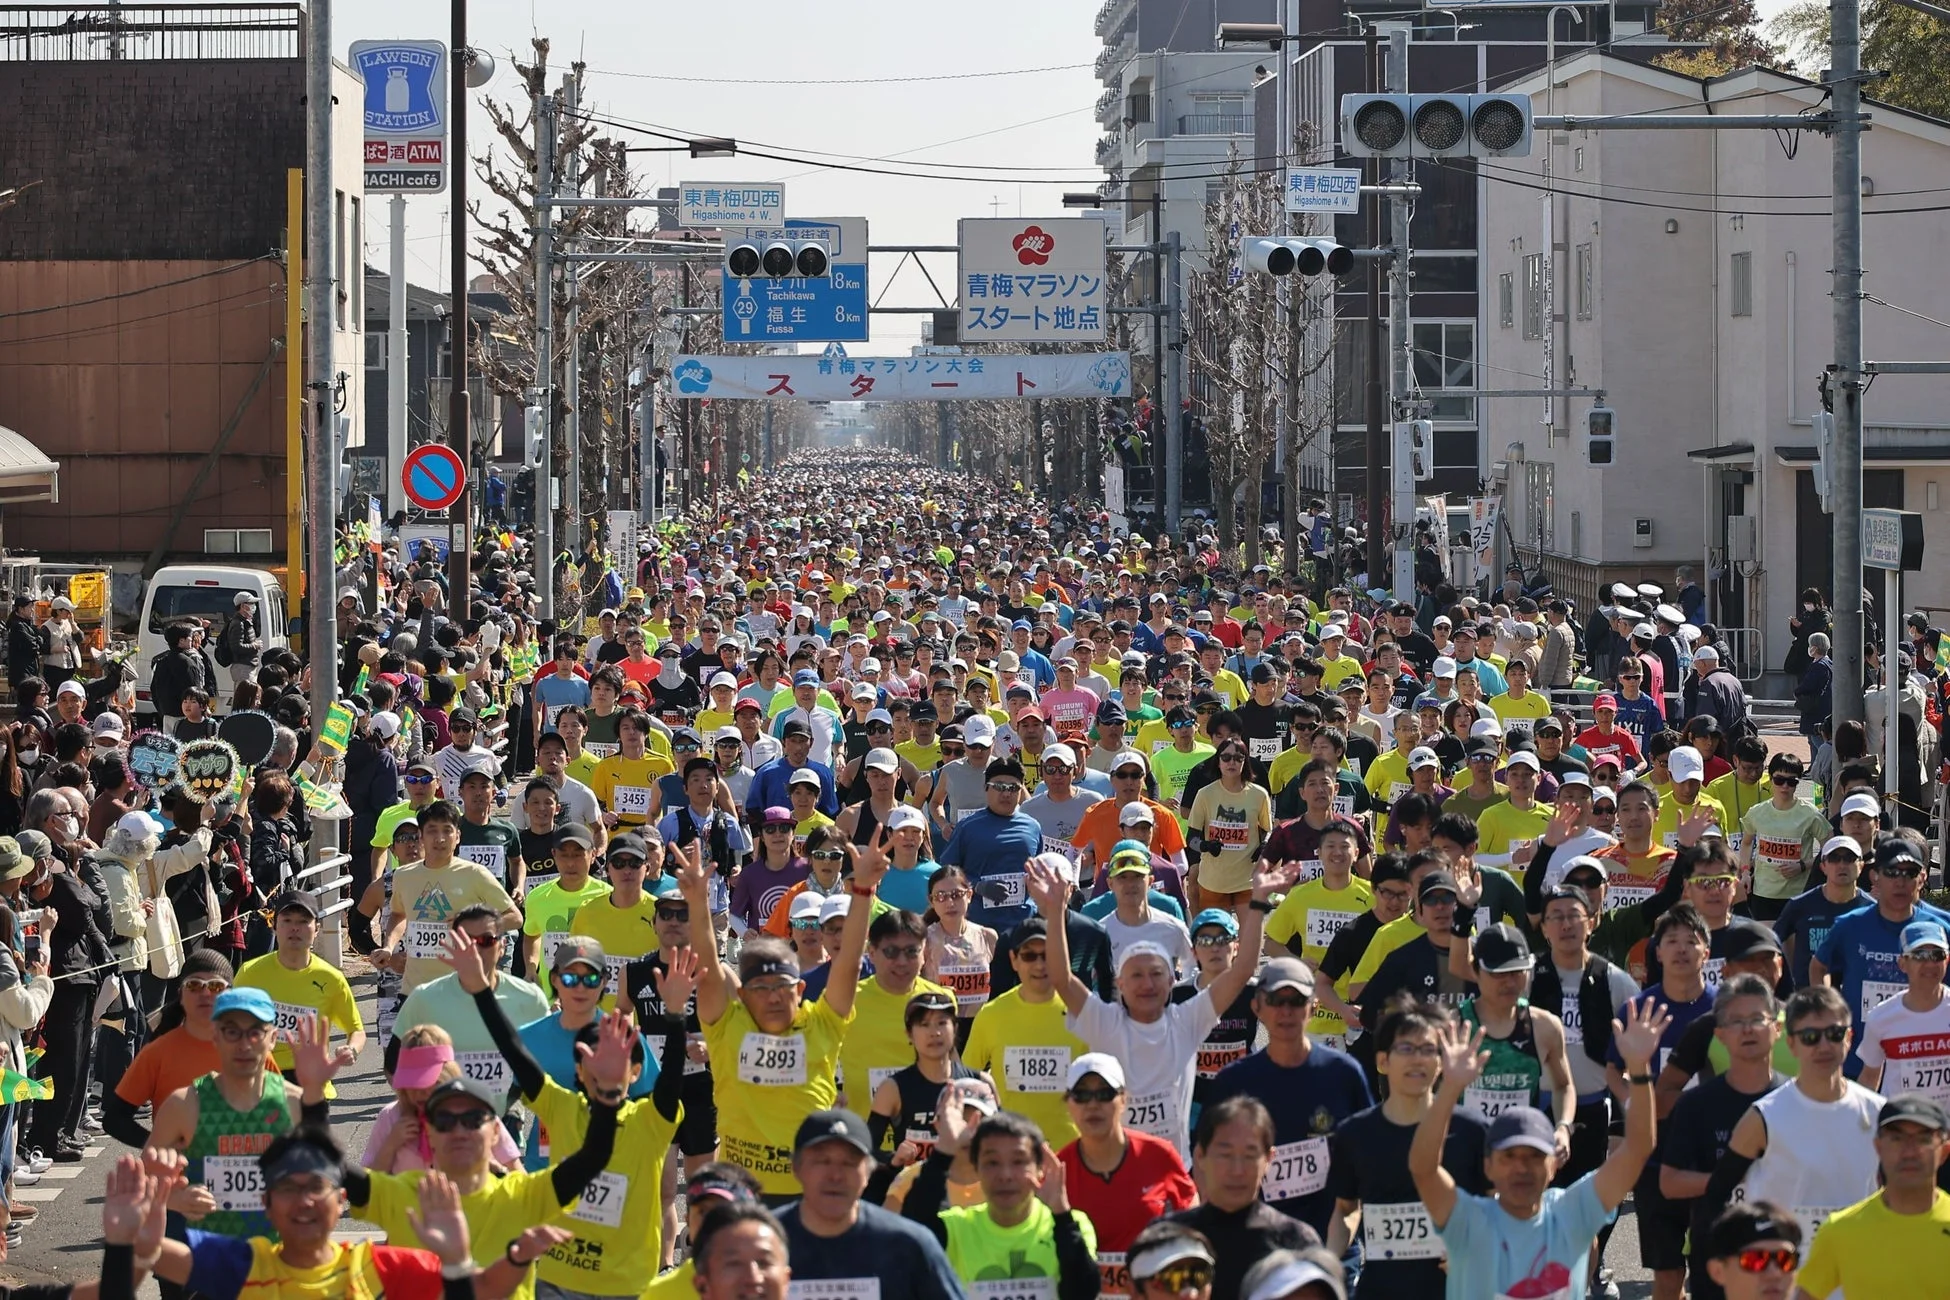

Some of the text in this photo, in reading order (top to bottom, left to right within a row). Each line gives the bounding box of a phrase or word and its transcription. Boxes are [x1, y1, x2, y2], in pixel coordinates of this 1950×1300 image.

[363, 51, 432, 67] LAWSON
[365, 110, 431, 126] STATION
[390, 145, 405, 160] 酒
[409, 145, 439, 160] ATM
[406, 174, 438, 186] café
[1289, 174, 1357, 194] 東青梅四西
[684, 189, 780, 207] 東青梅四西
[1294, 196, 1350, 207] Higashiome 4 W.
[692, 210, 772, 221] Higashiome 4 W.
[968, 273, 1100, 298] 青梅マラソン
[767, 291, 816, 300] Tachikawa
[737, 302, 753, 314] 29
[767, 307, 807, 323] 福生
[967, 305, 1100, 330] スタート地点
[767, 325, 794, 333] Fussa
[817, 358, 985, 375] 青梅マラソン大会
[766, 373, 1037, 397] スタート
[146, 736, 170, 751] ひろこ
[1256, 744, 1277, 754] 2969
[131, 746, 178, 776] 宏子
[186, 753, 229, 777] ヤザワ
[623, 793, 645, 806] 3455
[1215, 828, 1245, 841] 20342
[1766, 842, 1796, 856] 20315
[470, 853, 496, 867] 3297
[948, 973, 985, 991] 20314
[645, 1001, 695, 1016] INES
[740, 1047, 796, 1068] H 2893
[464, 1062, 503, 1081] 3224
[1019, 1058, 1057, 1077] 1882
[1128, 1102, 1165, 1125] 2751
[725, 1135, 737, 1146] THE
[726, 1151, 754, 1170] ROAD
[755, 1158, 792, 1174] RACE
[1274, 1153, 1317, 1181] 2778
[585, 1183, 610, 1206] 87
[1367, 1217, 1427, 1241] H 3275
[566, 1254, 601, 1272] RACE
